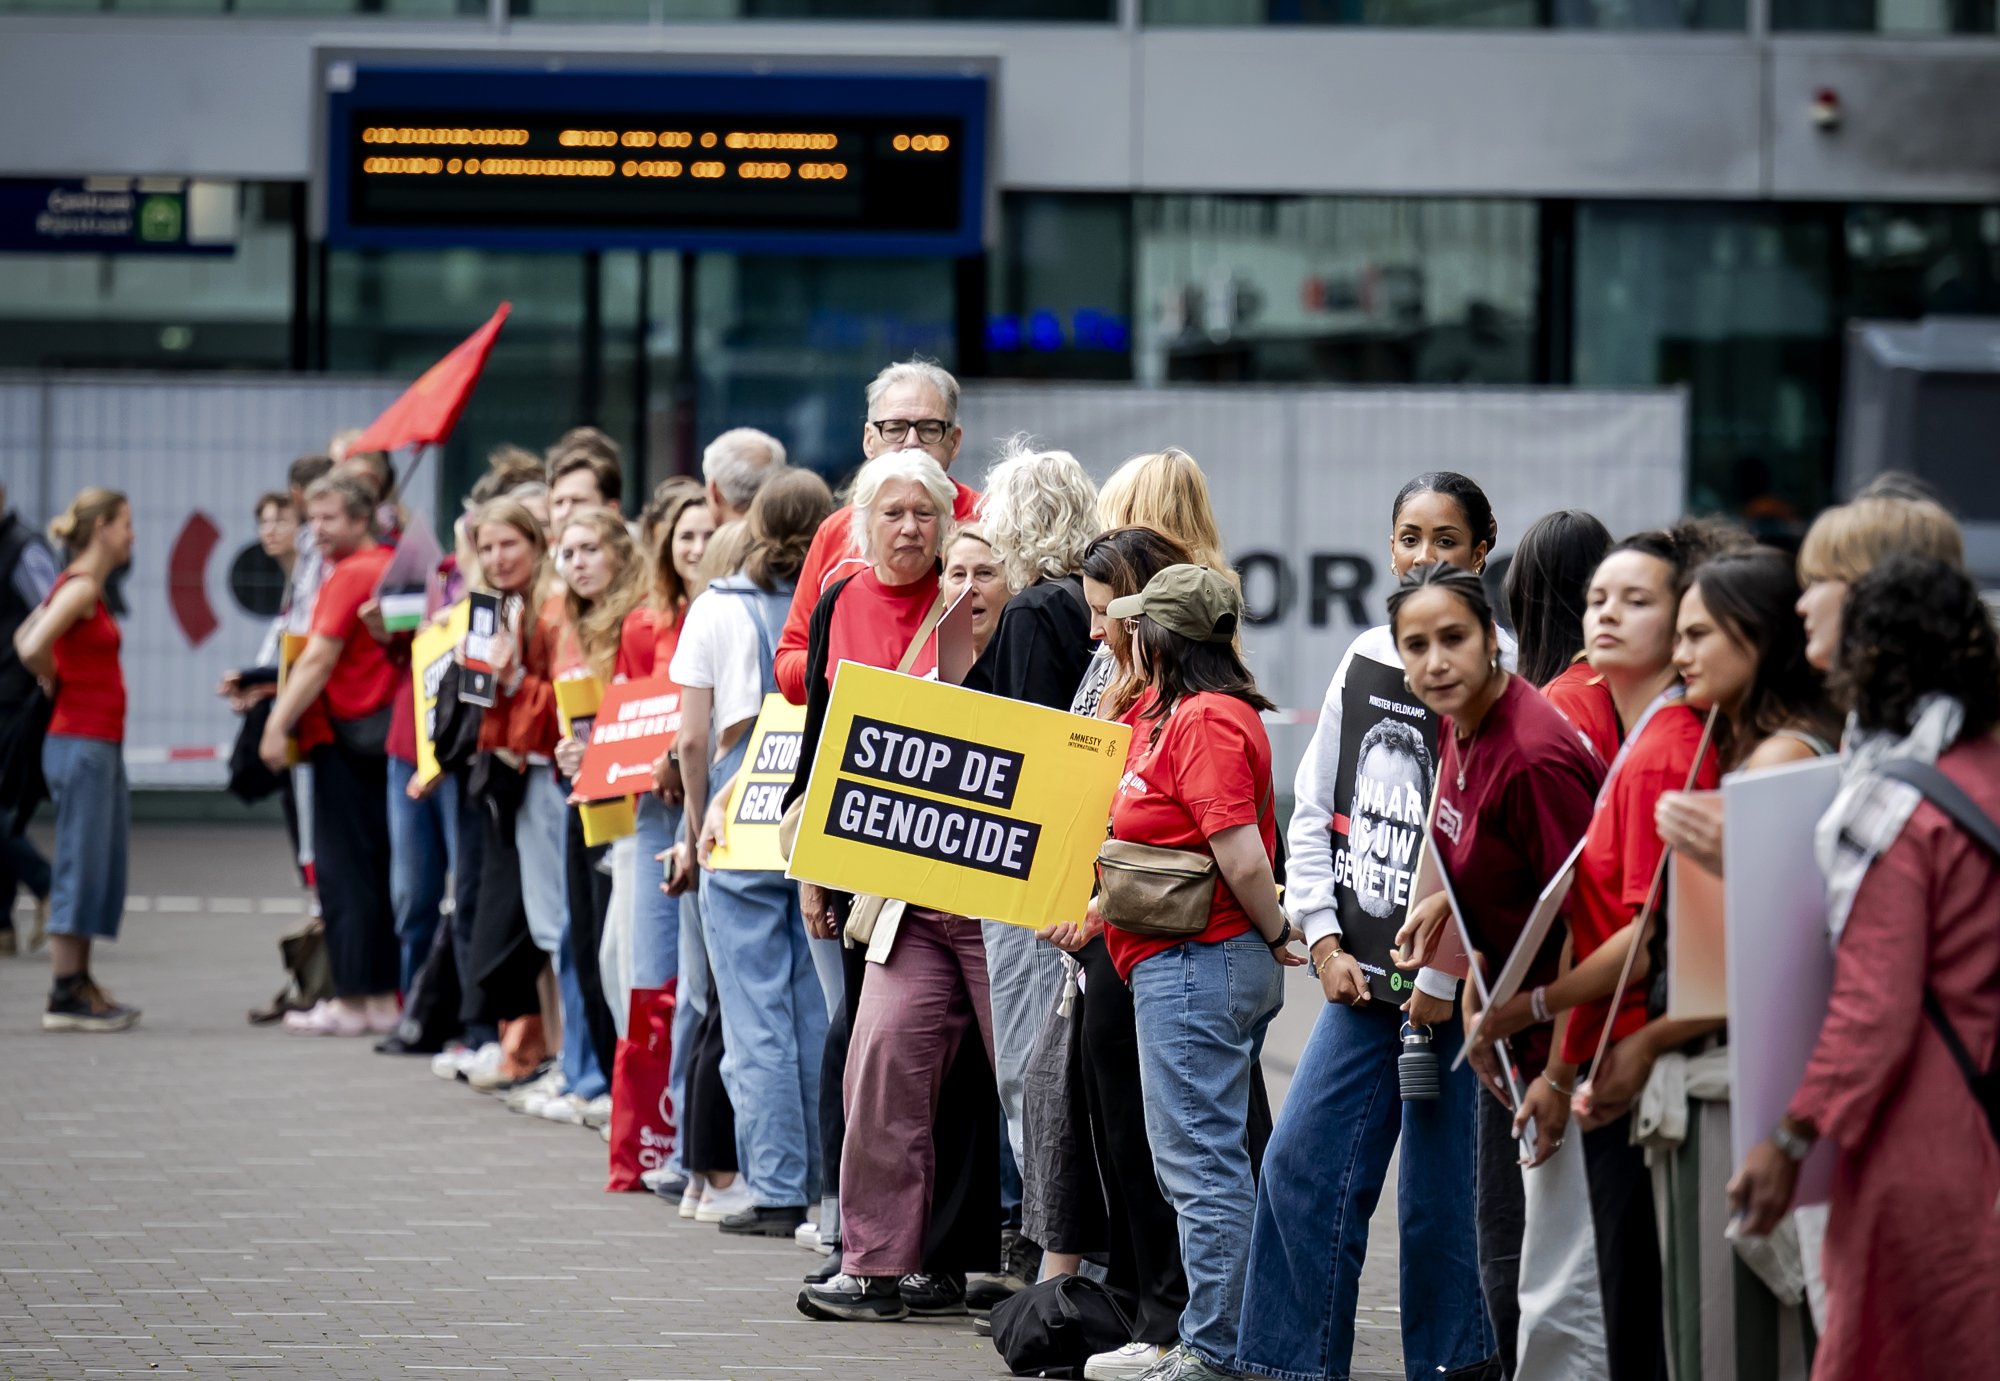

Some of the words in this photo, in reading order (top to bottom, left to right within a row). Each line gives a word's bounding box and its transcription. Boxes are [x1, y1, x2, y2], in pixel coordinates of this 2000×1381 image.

[1368, 694, 1391, 710] MINISTER
[1391, 702, 1427, 720] VELDKAMP,
[854, 726, 951, 782] STOP
[958, 750, 1012, 799] DE
[1069, 732, 1102, 746] AMNESTY
[1357, 774, 1421, 826] WAAR
[839, 790, 1029, 870] GENOCIDE
[1354, 816, 1371, 851] IS
[1375, 823, 1416, 865] UW
[1334, 847, 1417, 906] GEWETE
[1403, 980, 1413, 990] OXF
